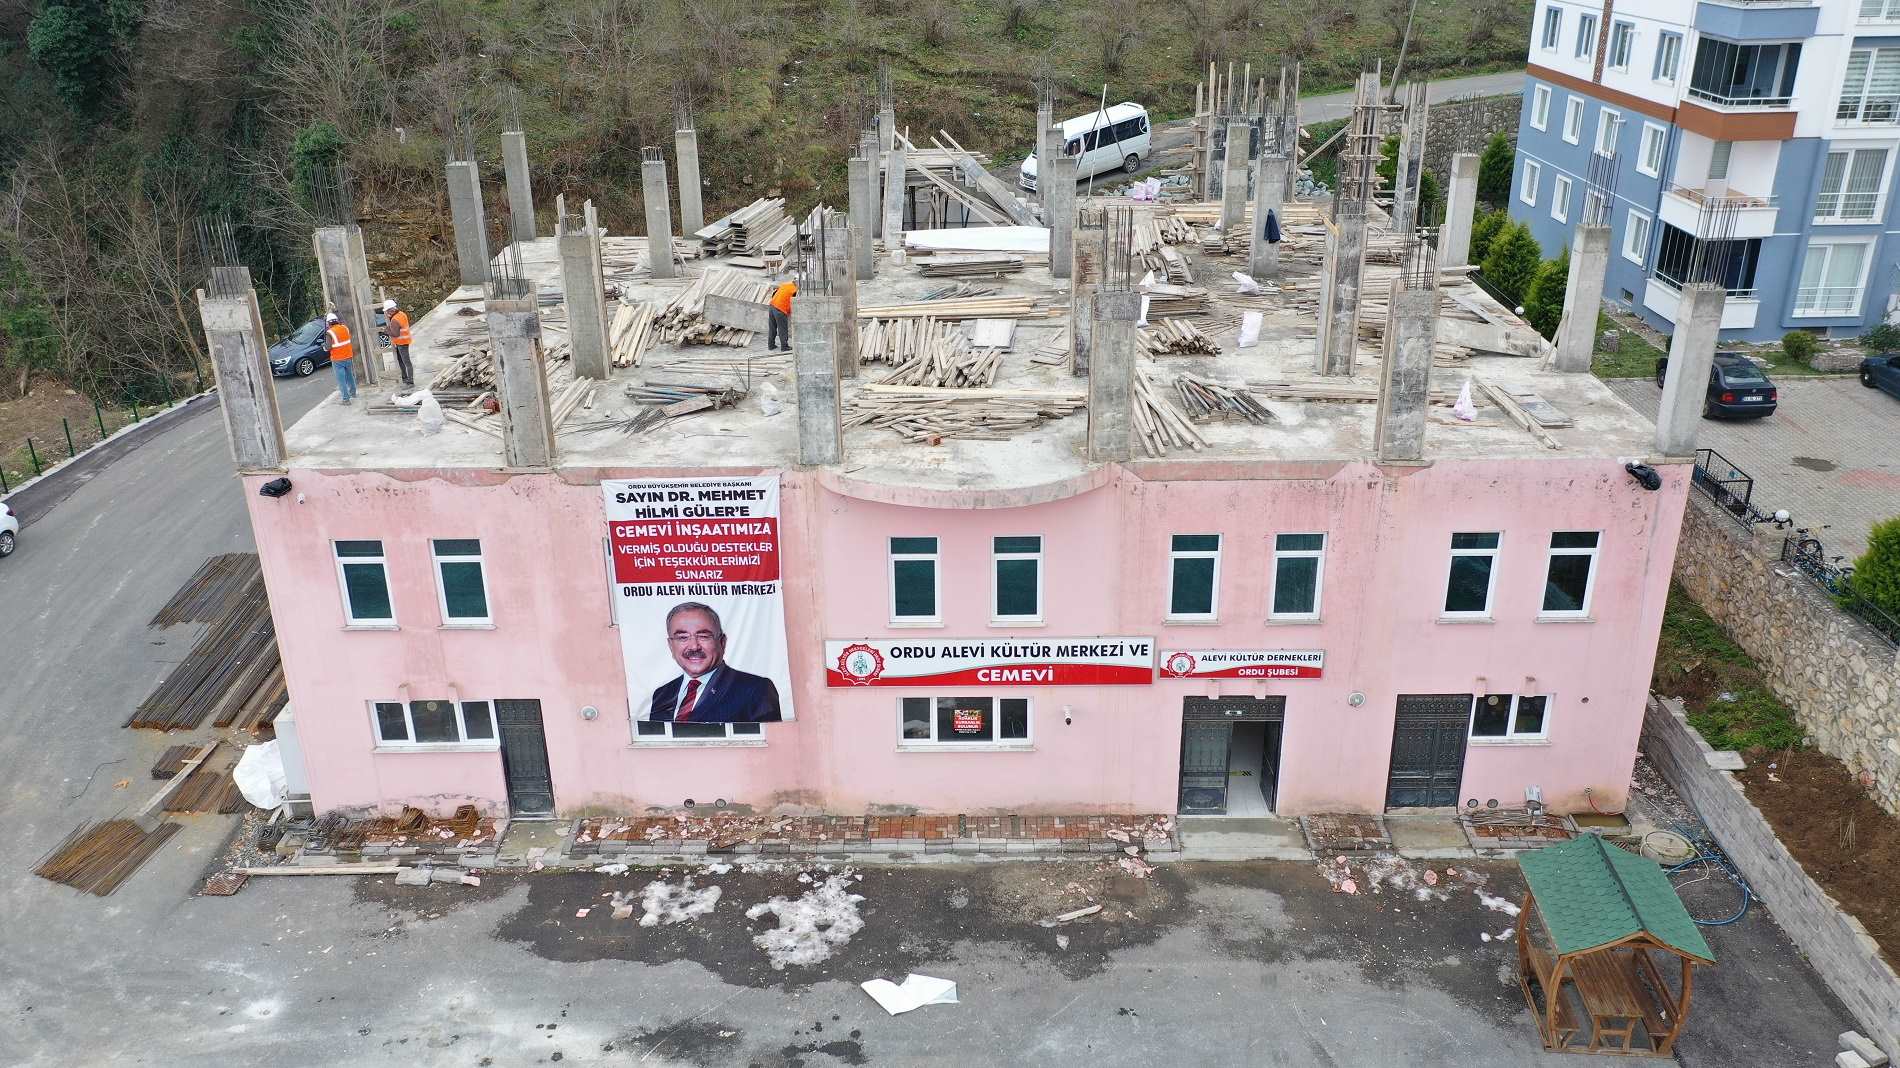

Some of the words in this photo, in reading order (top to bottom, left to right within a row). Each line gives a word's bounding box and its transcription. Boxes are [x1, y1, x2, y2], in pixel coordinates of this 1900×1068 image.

[616, 491, 664, 503] SAYIN
[667, 491, 695, 502] DR.
[698, 489, 766, 501] MEHMET
[635, 504, 679, 518] HİLMİ
[615, 521, 672, 538] CEMEVİ
[675, 521, 772, 539] İNŞAATIMIZA
[618, 541, 661, 555] VERMİŞ
[663, 541, 709, 553] OLDUĞU
[711, 542, 773, 553] DESTEKLER
[633, 556, 656, 569] İÇİN
[658, 553, 761, 569] TEŞEKKÜRLERİMİZİ
[675, 569, 724, 580] SUNARIZ
[623, 585, 653, 597] ORDU
[688, 582, 728, 596] KÜLTÜR
[890, 646, 936, 659] ORDU
[941, 642, 985, 658] ALEVİ
[990, 642, 1051, 658] KÜLTÜR
[1056, 640, 1124, 658] MERKEZİ
[1129, 644, 1149, 657] VE
[1201, 653, 1227, 662] ALEVİ
[1229, 652, 1265, 662] KÜLTÜR
[977, 665, 1054, 682] CEMEVİ
[1238, 668, 1265, 676] ORDU
[1267, 667, 1299, 677] ŞUBESİ
